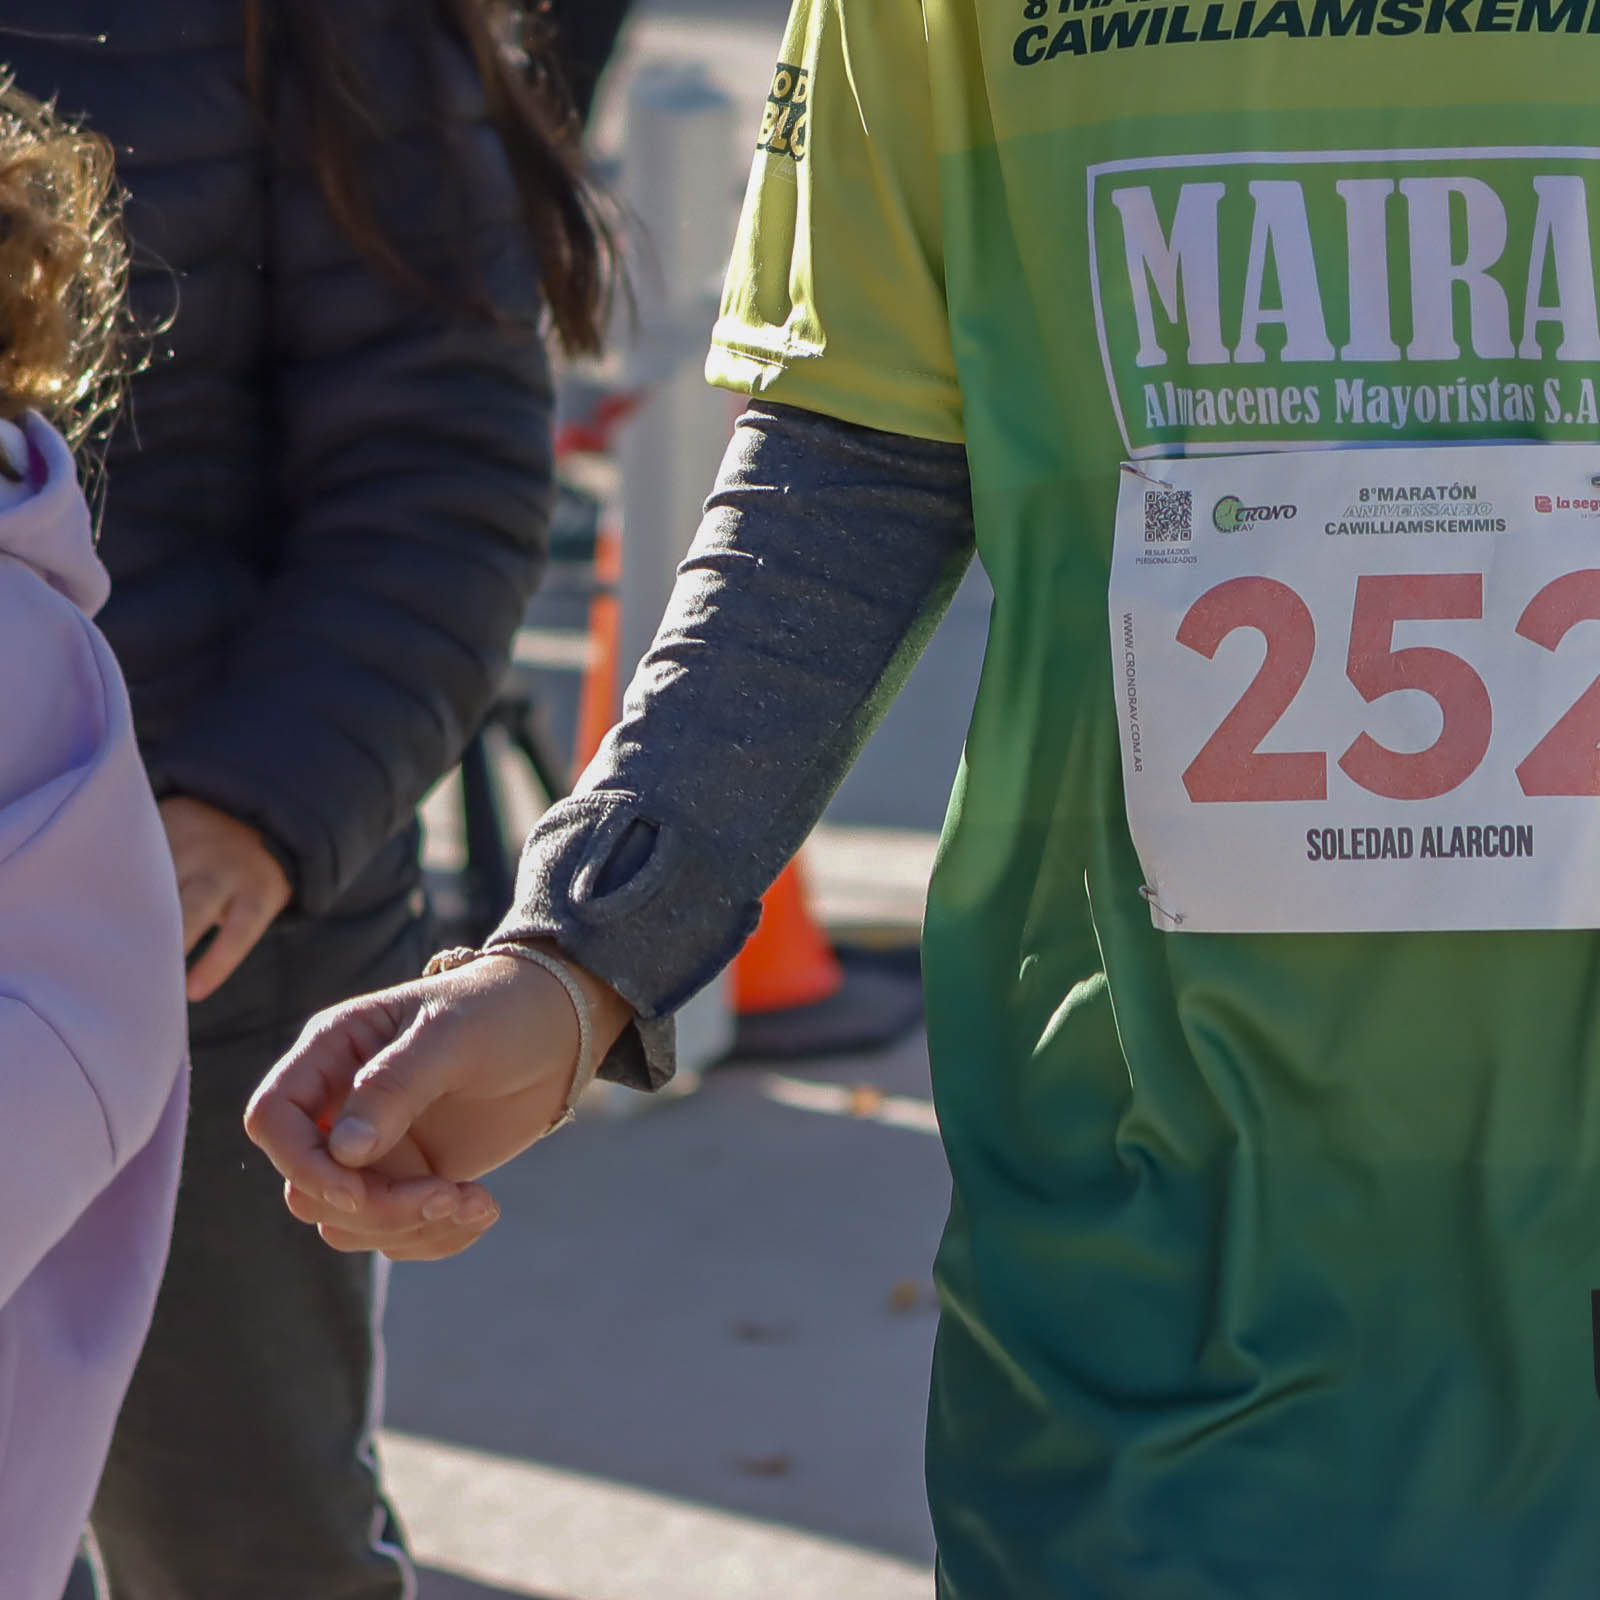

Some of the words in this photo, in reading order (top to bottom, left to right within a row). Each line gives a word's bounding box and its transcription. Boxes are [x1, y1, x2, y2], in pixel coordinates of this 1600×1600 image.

[1143, 380, 1321, 429] Almacenes
[1334, 375, 1535, 430] Mayoristas
[1556, 496, 1570, 509] la
[1324, 518, 1506, 535] CAWILLIAMSKEMMIS
[1122, 612, 1143, 773] WWW.CRONORAV.COM.AR
[1306, 826, 1414, 862] SOLEDAD
[1420, 824, 1534, 859] ALARCON
